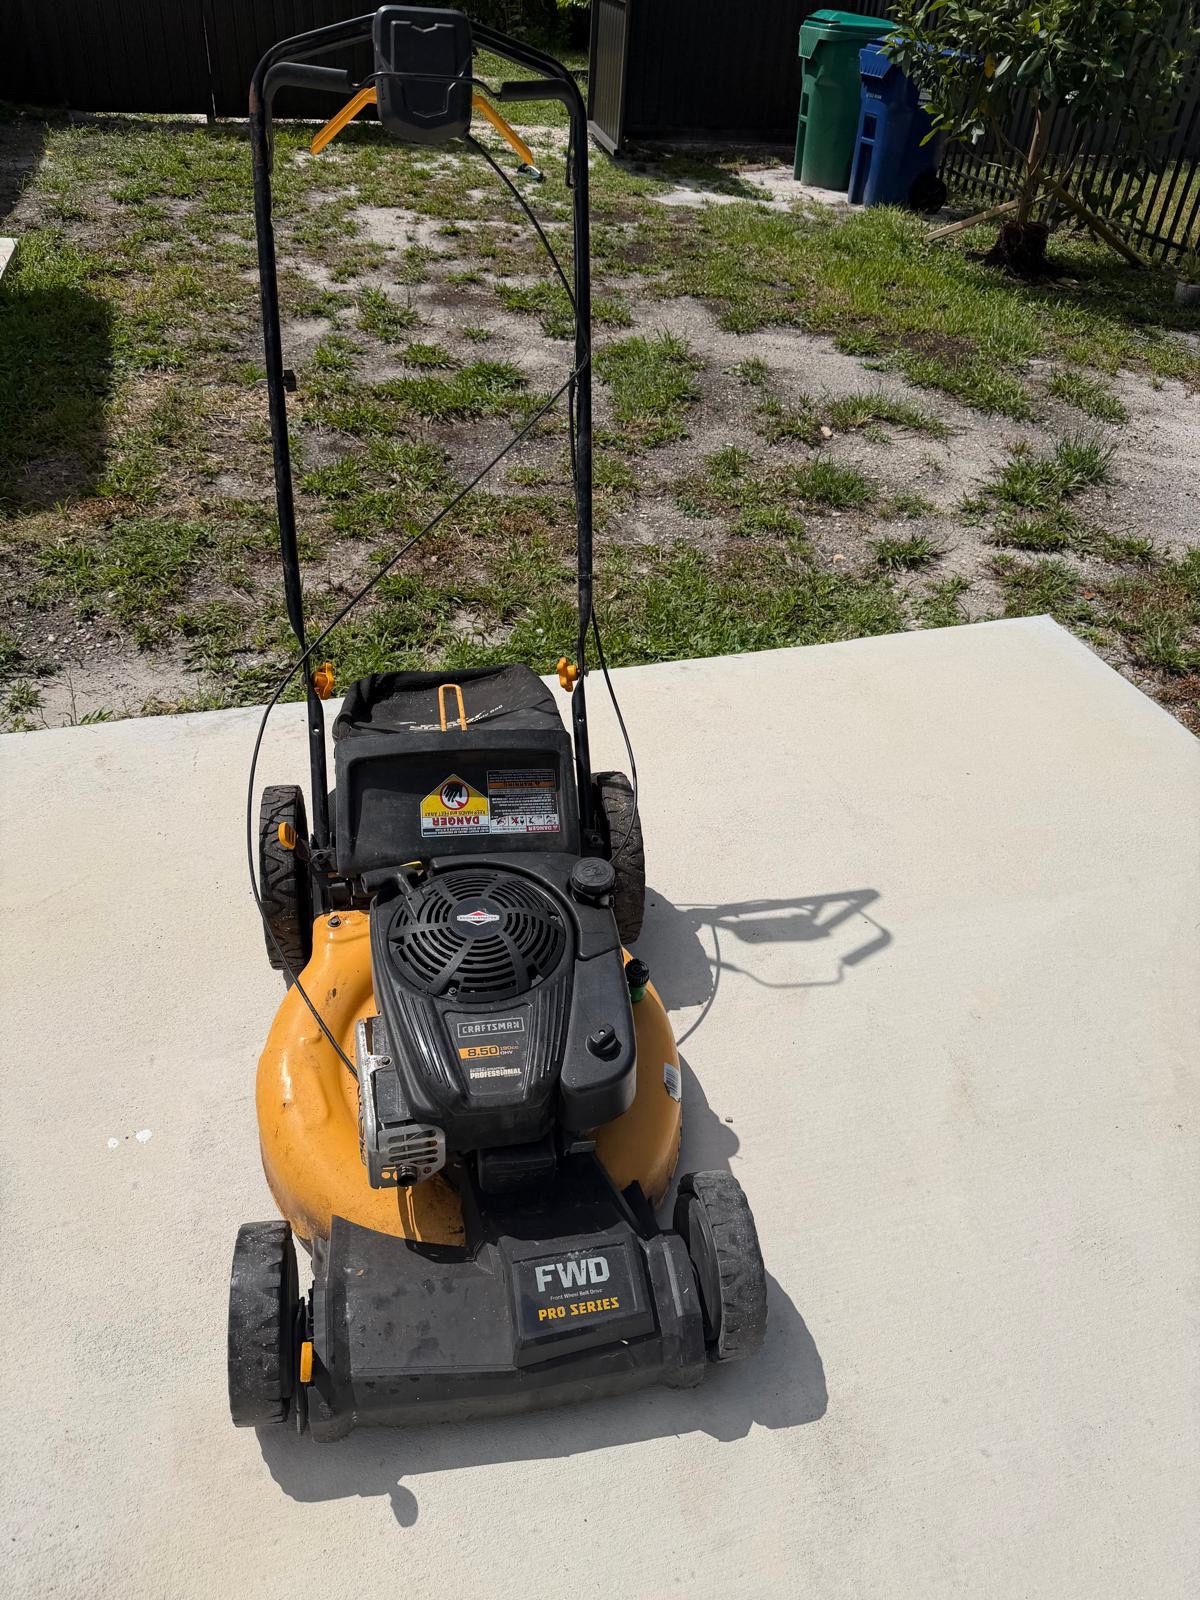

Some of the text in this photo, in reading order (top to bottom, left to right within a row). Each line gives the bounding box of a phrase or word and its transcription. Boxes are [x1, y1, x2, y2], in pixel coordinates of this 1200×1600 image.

[432, 816, 480, 827] DANGER
[462, 1021, 520, 1034] CRAFTSMAN
[467, 1046, 498, 1057] 8.50
[470, 1068, 522, 1079] PROFESSIONAL
[535, 1257, 610, 1292] FWD
[538, 1297, 620, 1321] PRO SERIES
